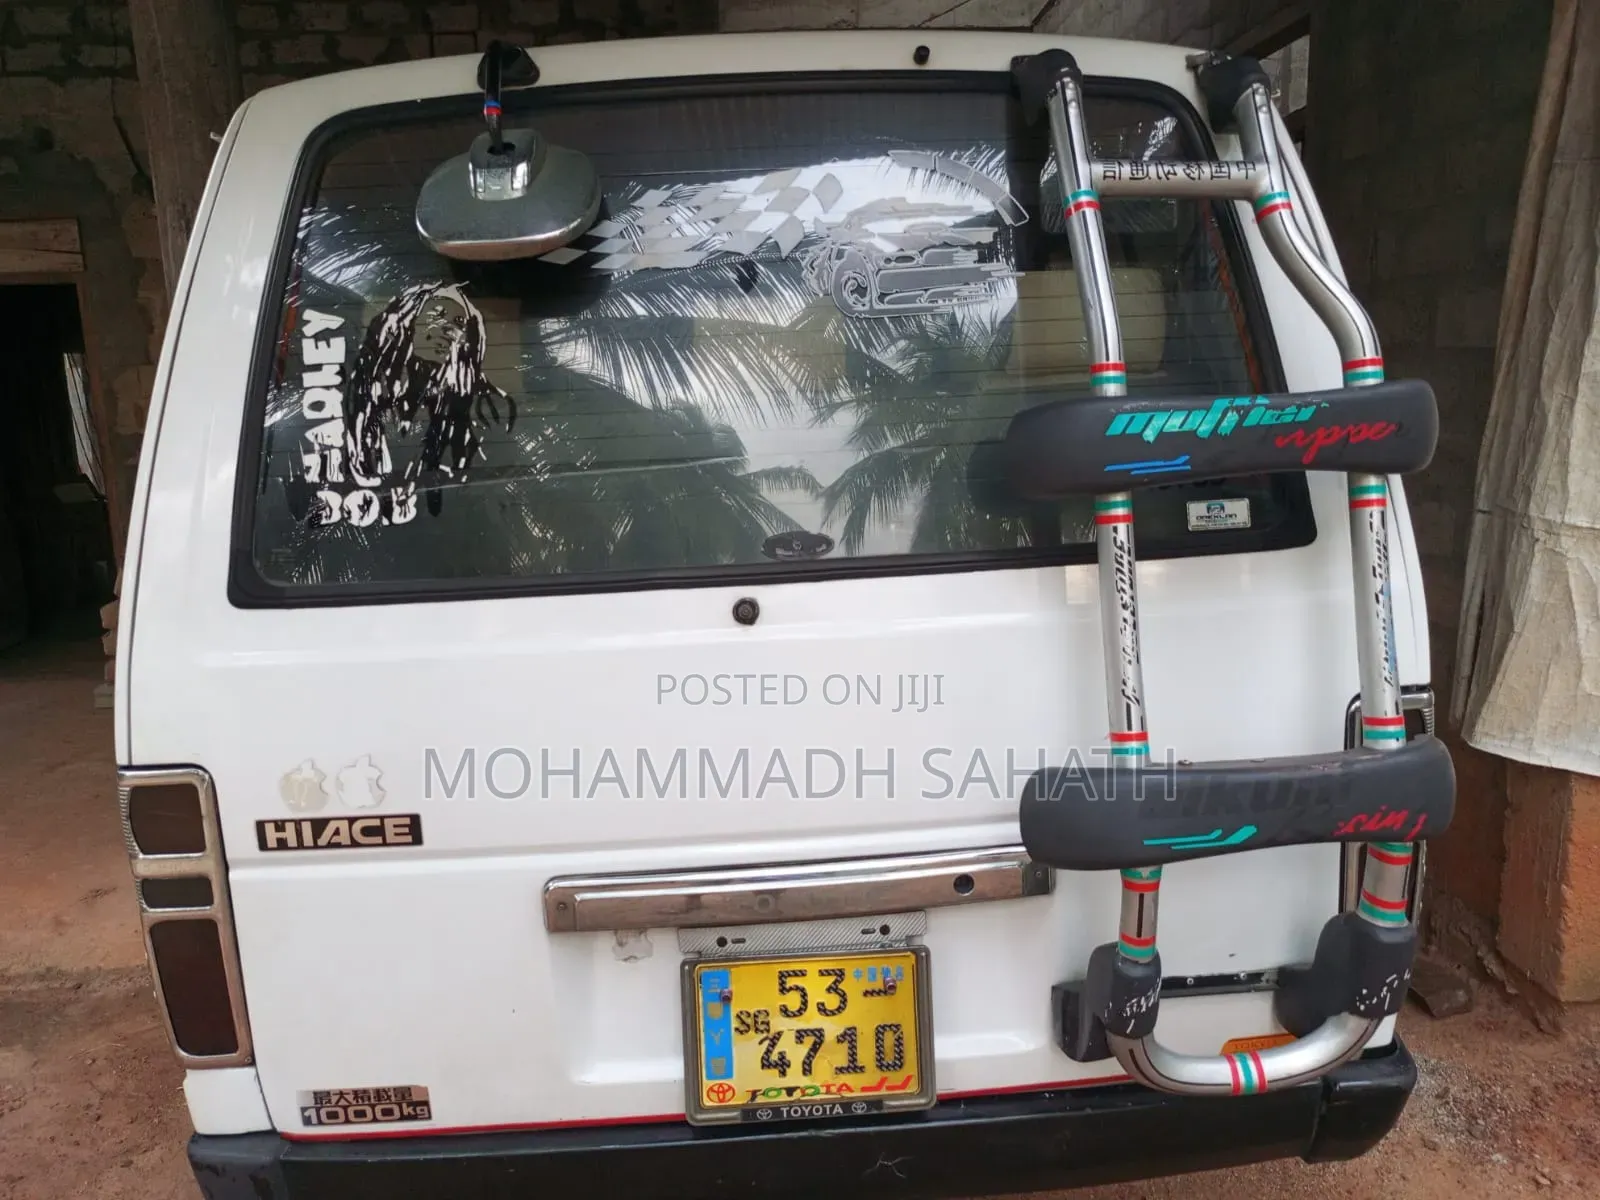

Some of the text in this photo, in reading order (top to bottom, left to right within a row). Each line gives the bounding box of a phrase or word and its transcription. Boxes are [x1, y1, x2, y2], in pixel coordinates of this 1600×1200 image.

[263, 816, 413, 849] HIACE
[734, 1009, 771, 1036] SG
[758, 1023, 906, 1078] 4710
[743, 1081, 854, 1104] TOYOTA
[303, 1102, 429, 1125] 1000kg
[780, 1103, 844, 1118] TOYOTA
